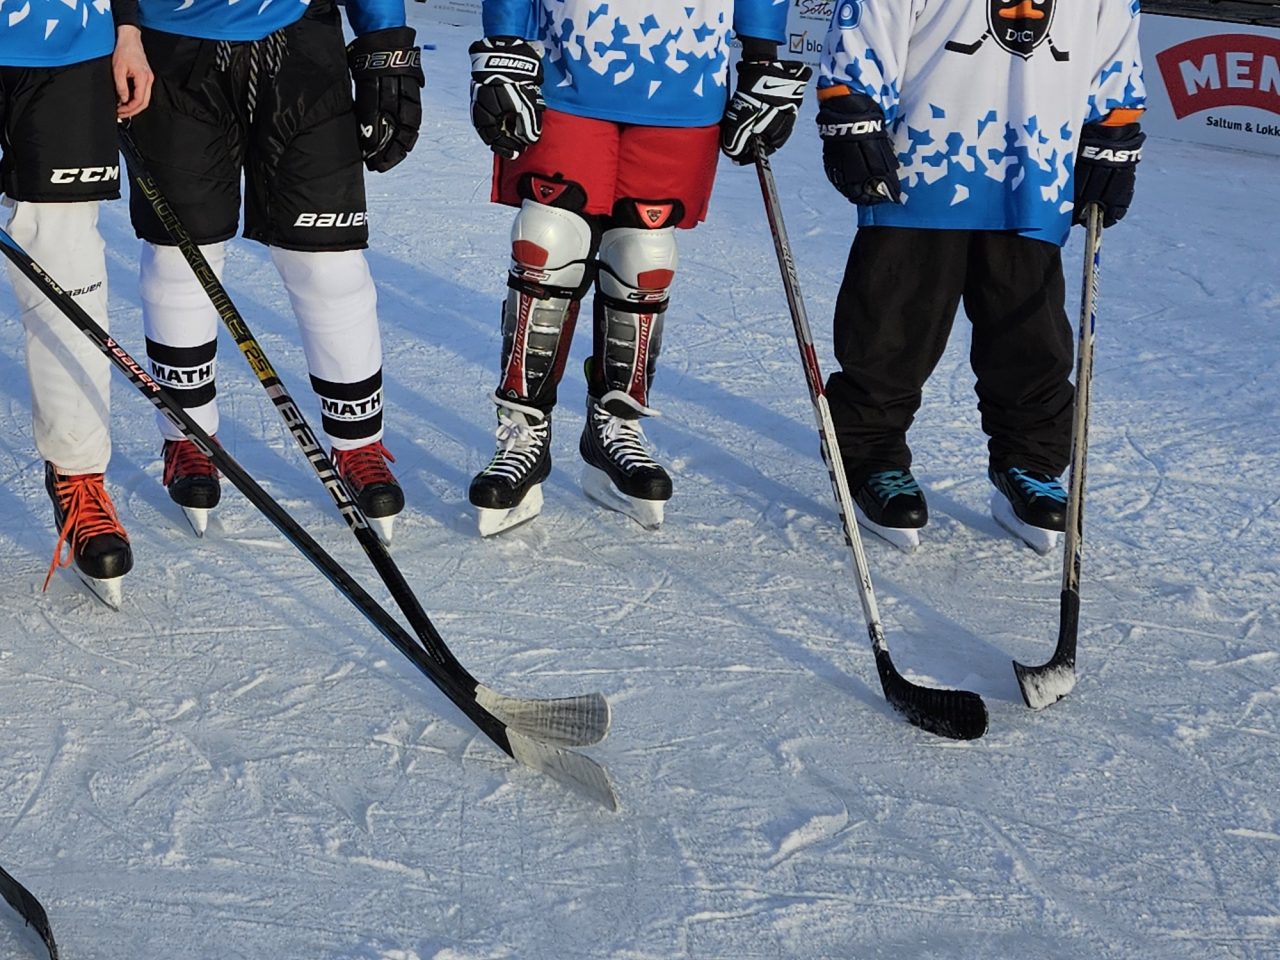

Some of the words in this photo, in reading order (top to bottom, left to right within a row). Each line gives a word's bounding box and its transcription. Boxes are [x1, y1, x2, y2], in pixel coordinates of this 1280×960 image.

[489, 57, 534, 71] BAUER
[1206, 115, 1242, 131] Saltum
[1244, 122, 1253, 133] &
[50, 166, 119, 184] CCM
[634, 316, 650, 385] SUPREME
[152, 363, 213, 384] MATH
